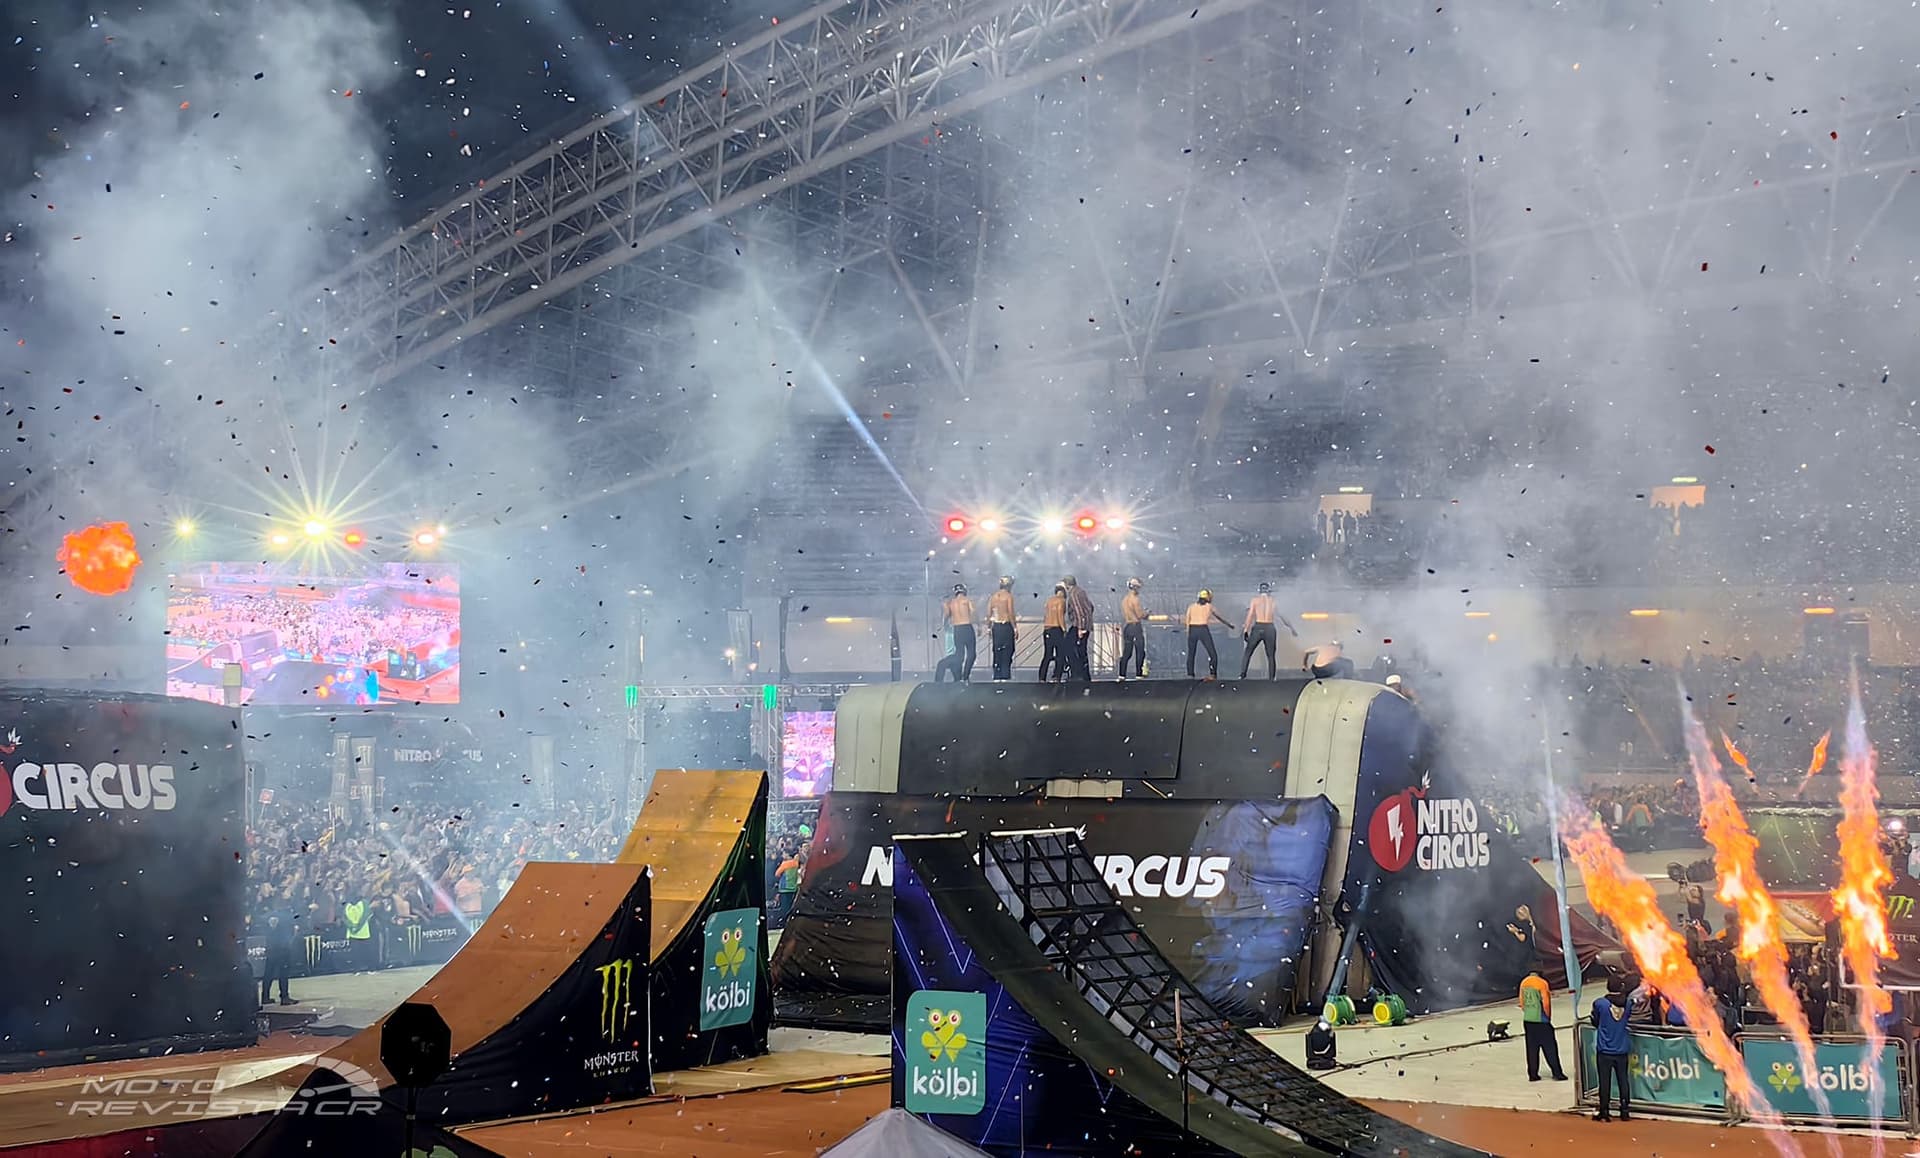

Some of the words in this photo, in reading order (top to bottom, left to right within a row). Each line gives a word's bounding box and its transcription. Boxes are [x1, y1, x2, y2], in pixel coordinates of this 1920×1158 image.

[12, 762, 177, 810] CIRCUS
[1417, 798, 1478, 834] NITRO
[1416, 832, 1490, 871] CIRCUS
[1093, 854, 1231, 898] RCUS
[705, 980, 751, 1014] kölbi
[584, 1050, 639, 1070] MONSTER
[912, 1065, 977, 1099] kölbi
